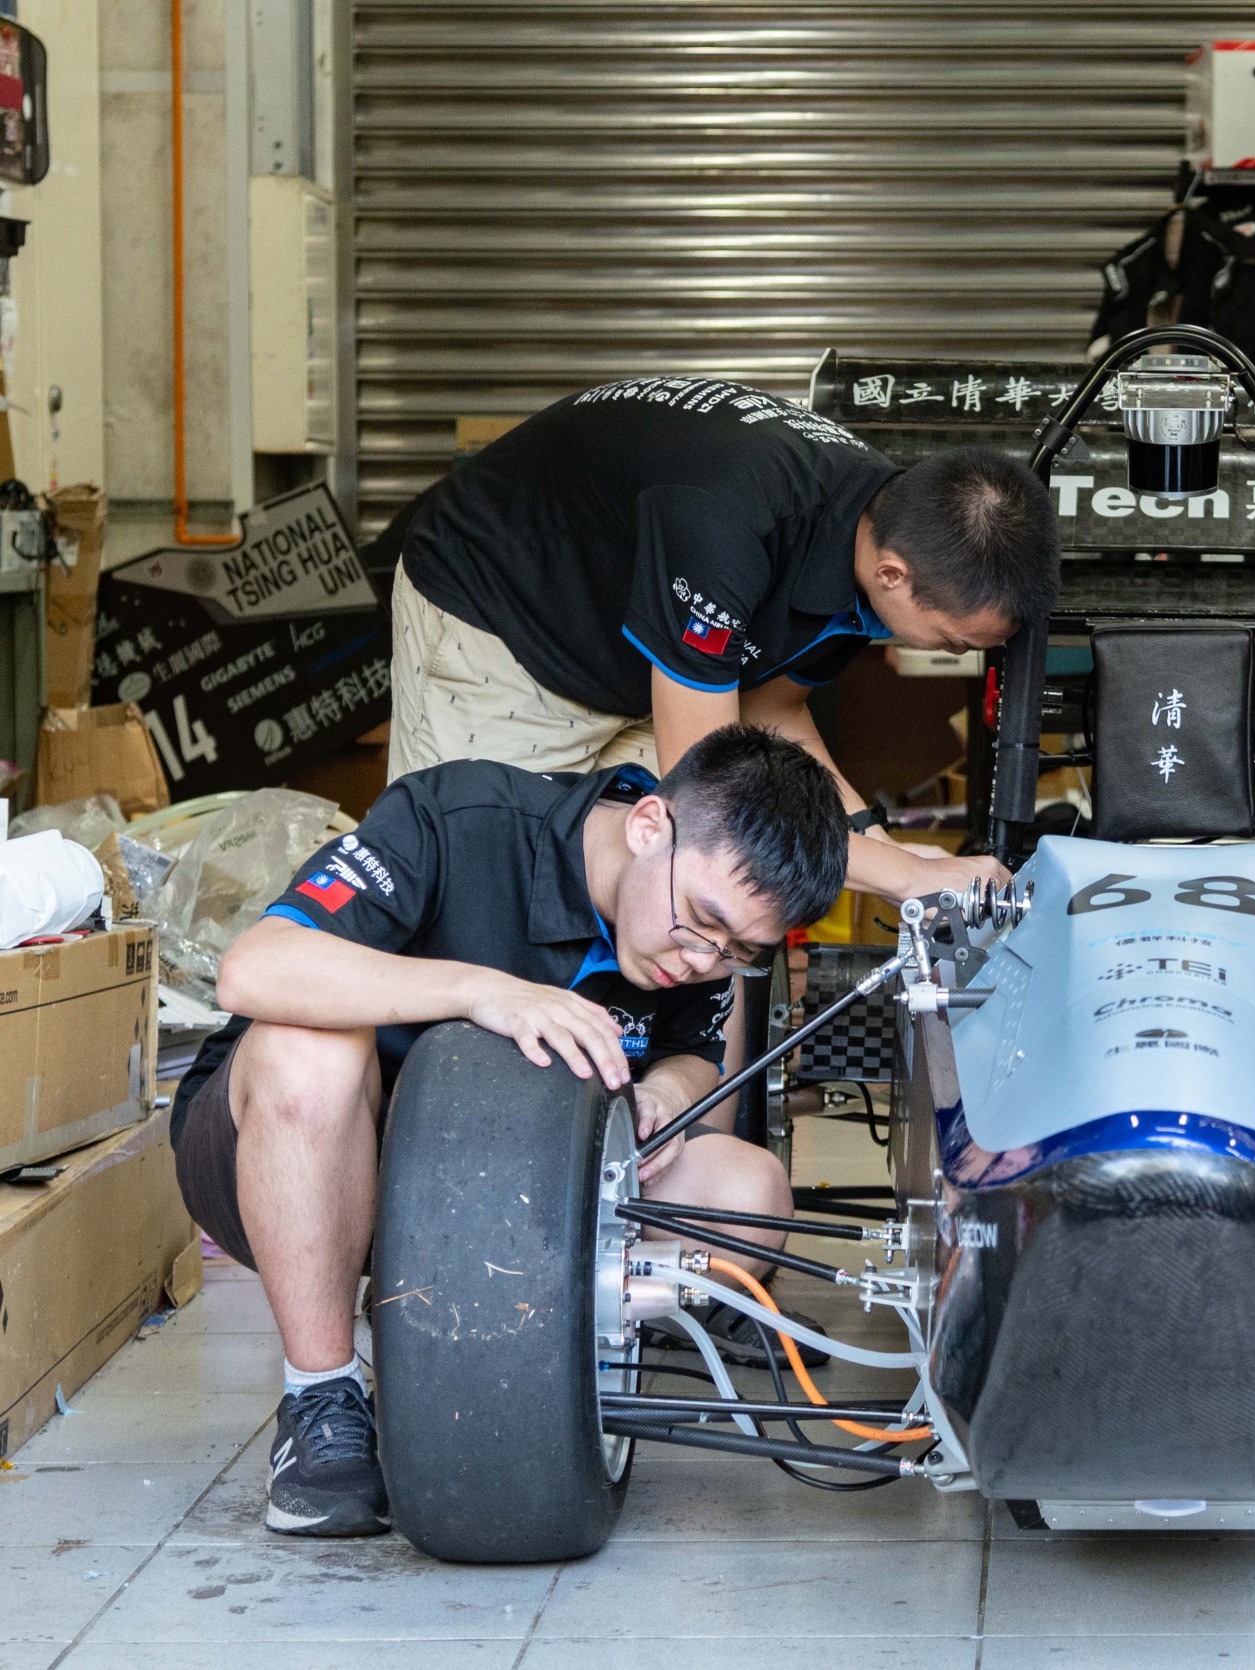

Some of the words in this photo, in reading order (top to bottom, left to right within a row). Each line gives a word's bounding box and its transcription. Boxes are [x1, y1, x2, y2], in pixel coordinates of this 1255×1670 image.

[223, 506, 338, 583] NATIONAL
[225, 559, 297, 613] TSING
[296, 530, 351, 576] HUA
[318, 556, 361, 597] UNI
[200, 639, 277, 693] GIGABYTE
[227, 664, 298, 715] SIEMENS
[284, 657, 391, 744] 惠特科技
[143, 693, 219, 782] 14
[353, 846, 395, 896] 惠特科技
[1093, 995, 1233, 1017] Chroma
